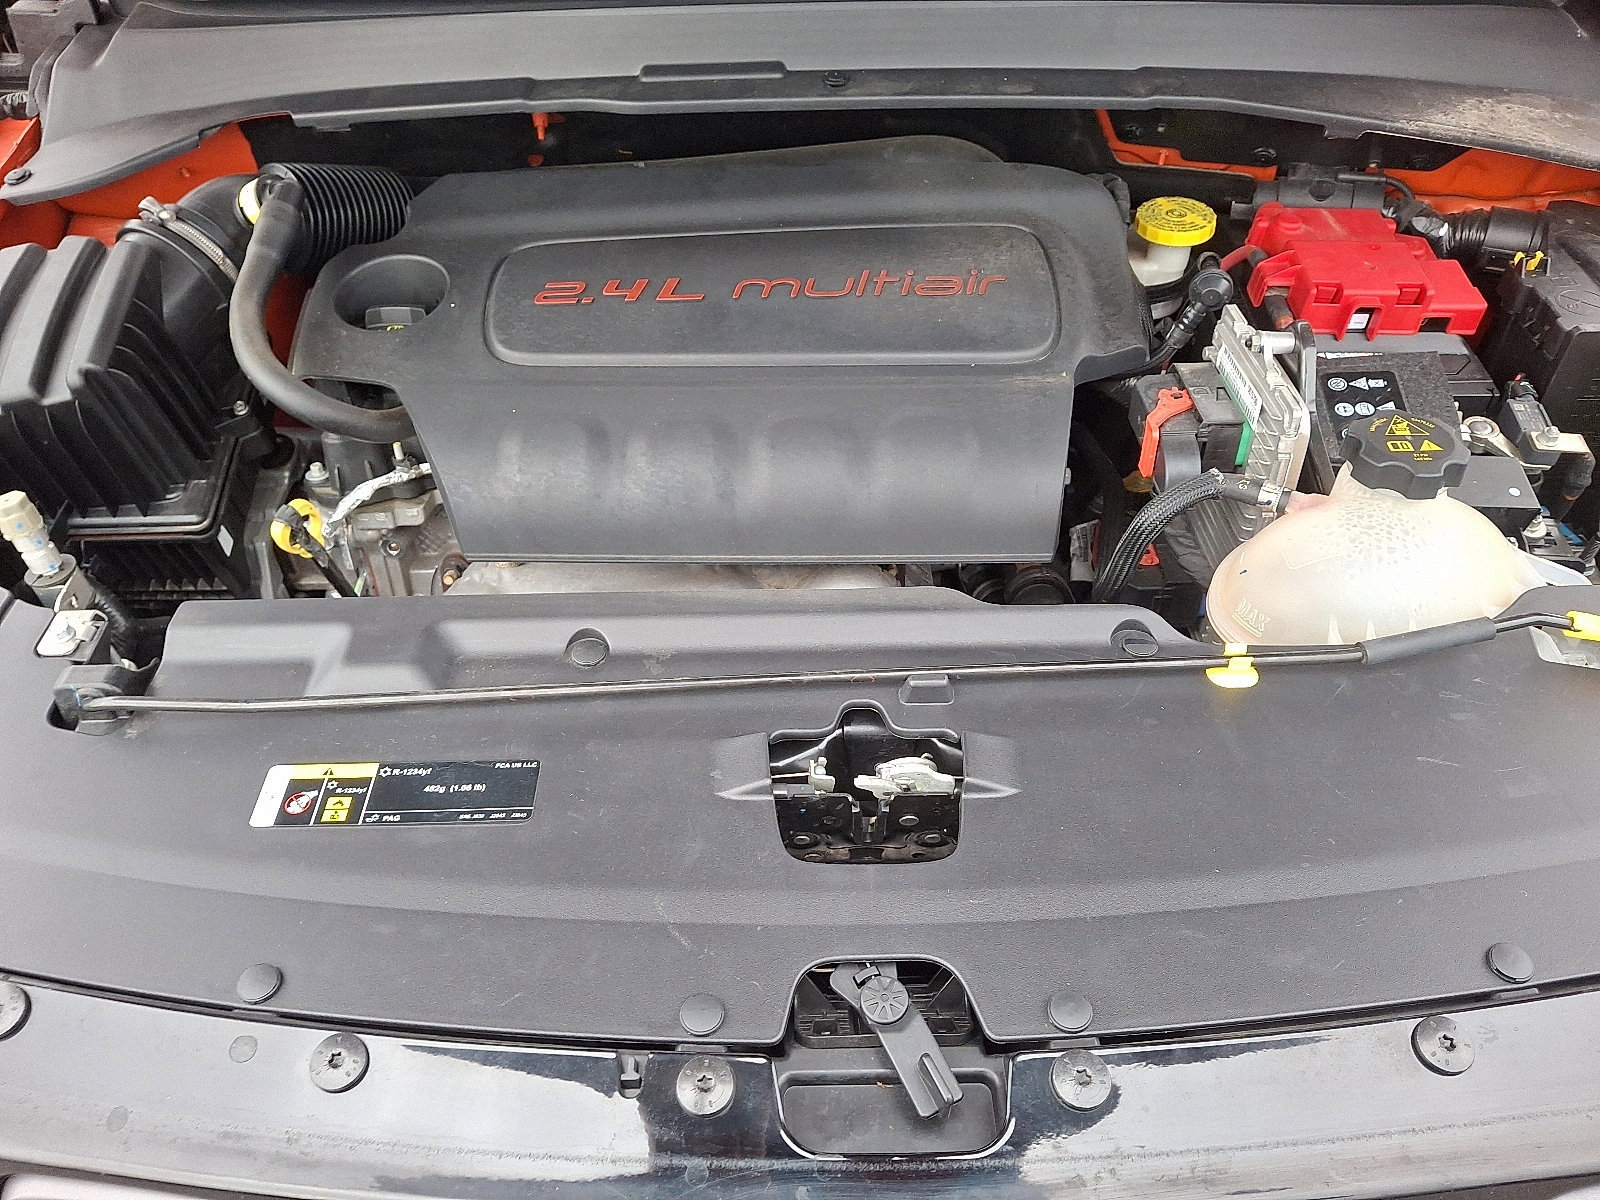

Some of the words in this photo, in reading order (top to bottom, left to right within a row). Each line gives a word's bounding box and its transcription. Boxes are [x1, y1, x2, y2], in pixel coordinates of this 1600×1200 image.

[732, 269, 1007, 299] multiair
[1234, 598, 1271, 632] MAX
[391, 767, 433, 777] R-1234yf
[382, 814, 400, 822] PAG
